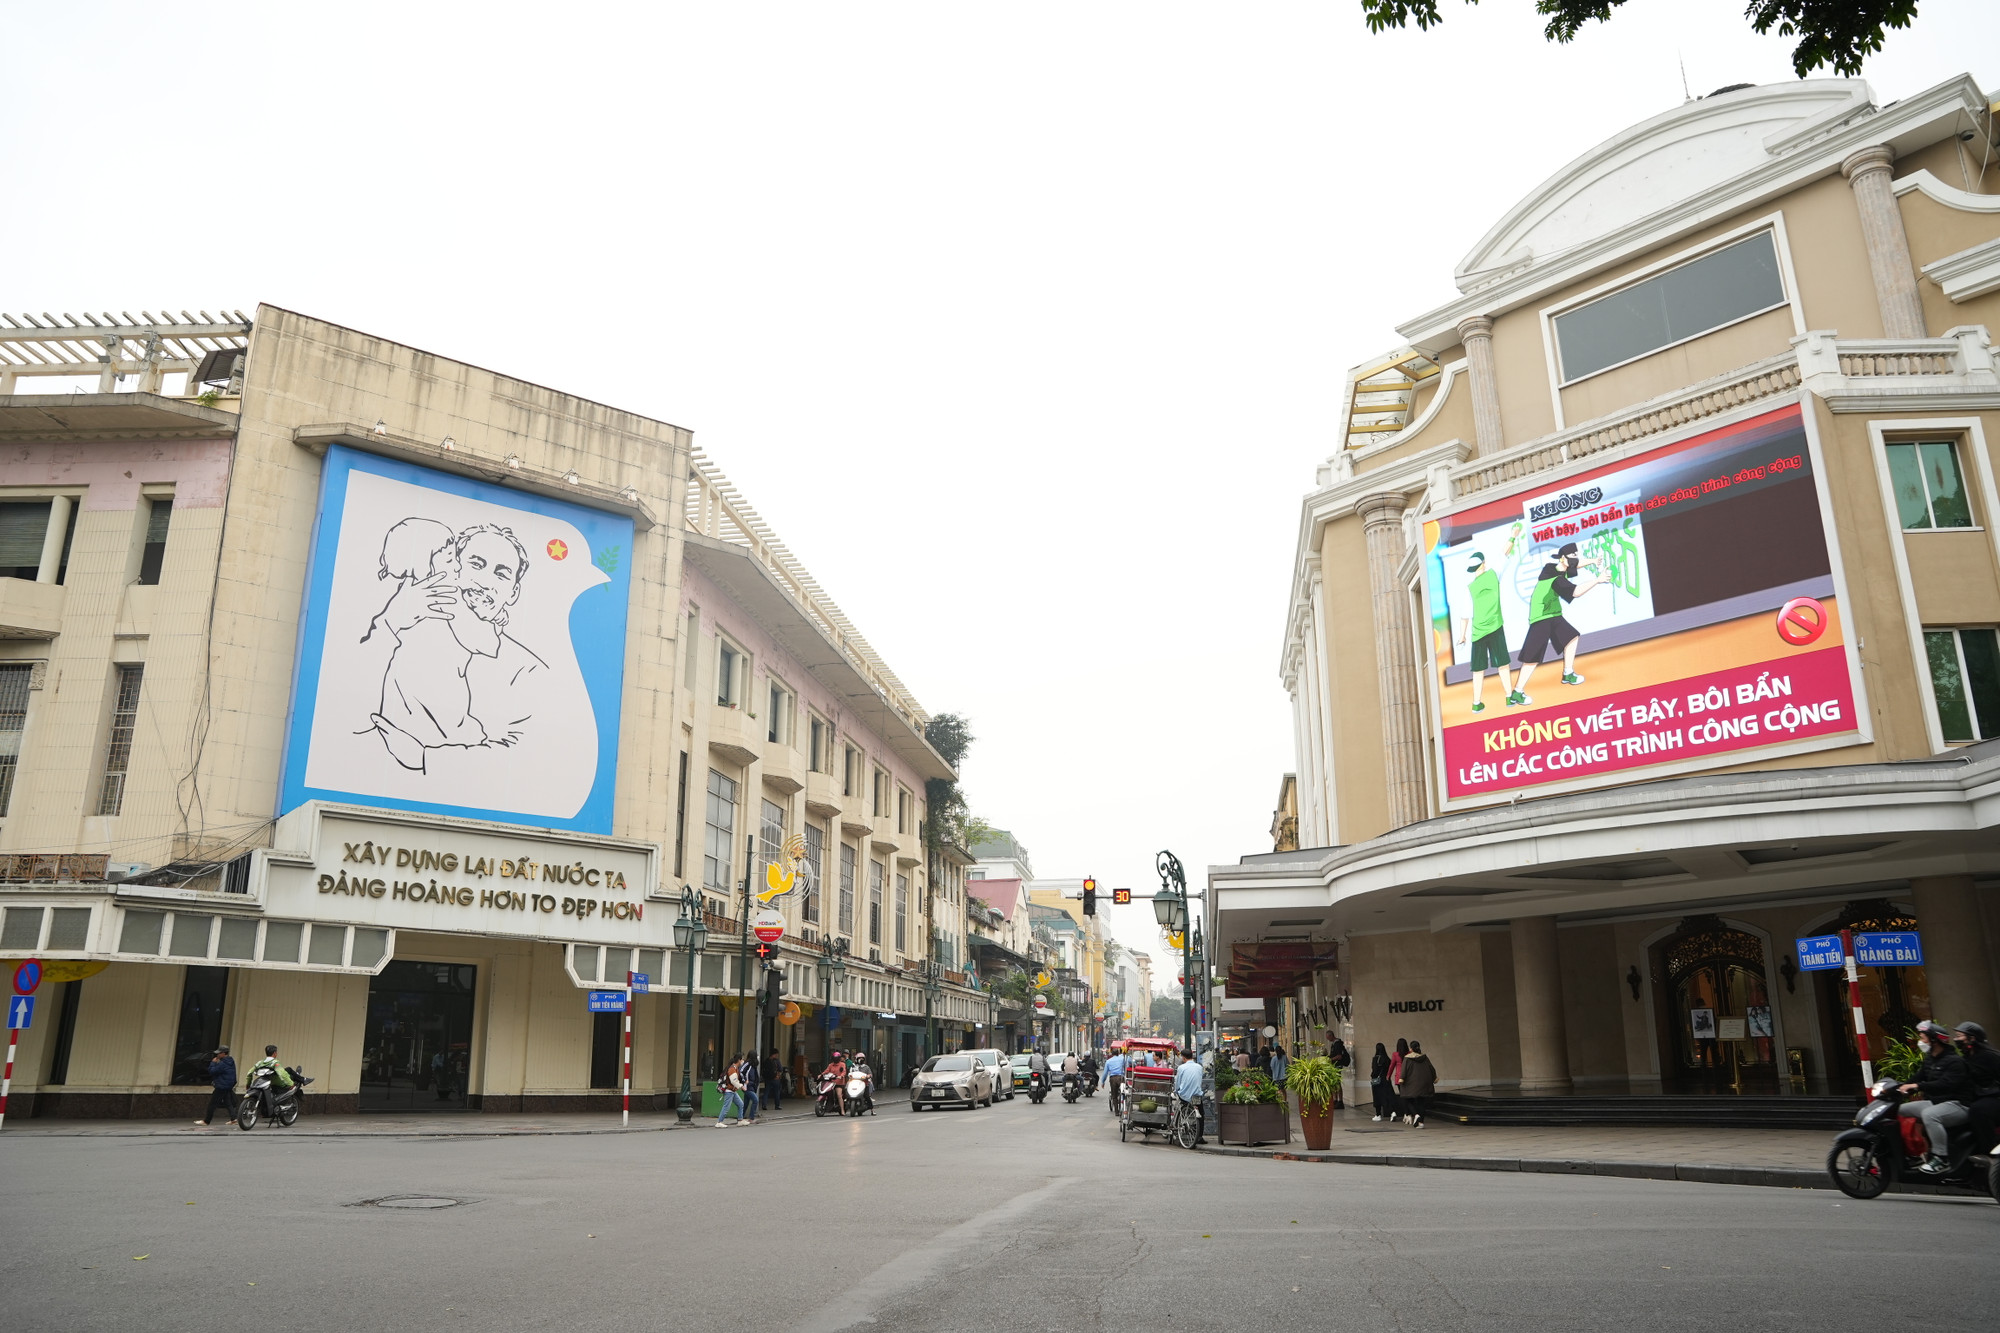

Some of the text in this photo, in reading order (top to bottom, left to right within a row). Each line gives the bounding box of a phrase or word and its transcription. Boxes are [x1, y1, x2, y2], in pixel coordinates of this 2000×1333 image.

[1529, 487, 1603, 522] KHÔNG
[1532, 455, 1802, 543] Viết bậy, bôi bẩn lên các công trình công cộng
[1484, 671, 1792, 752] KHÔNG VIẾT BẬY, BÔI BẨN
[1460, 699, 1841, 785] LÊN CÁC CÔNG TRÌNH CÔNG CỘNG
[343, 841, 627, 889] XÂY DỤNG LẠI ĐẤT NƯỚC TA
[318, 869, 643, 921] ĐÀNG HOÀNG HƠN TO ĐẸP HƠN
[1116, 891, 1129, 902] 30
[1816, 938, 1831, 948] PHỐ
[1880, 935, 1902, 944] PHỐ
[1802, 951, 1824, 966] TRÀNG
[1860, 946, 1917, 961] HÀNG BÀI
[1388, 1000, 1444, 1013] HUBLOT
